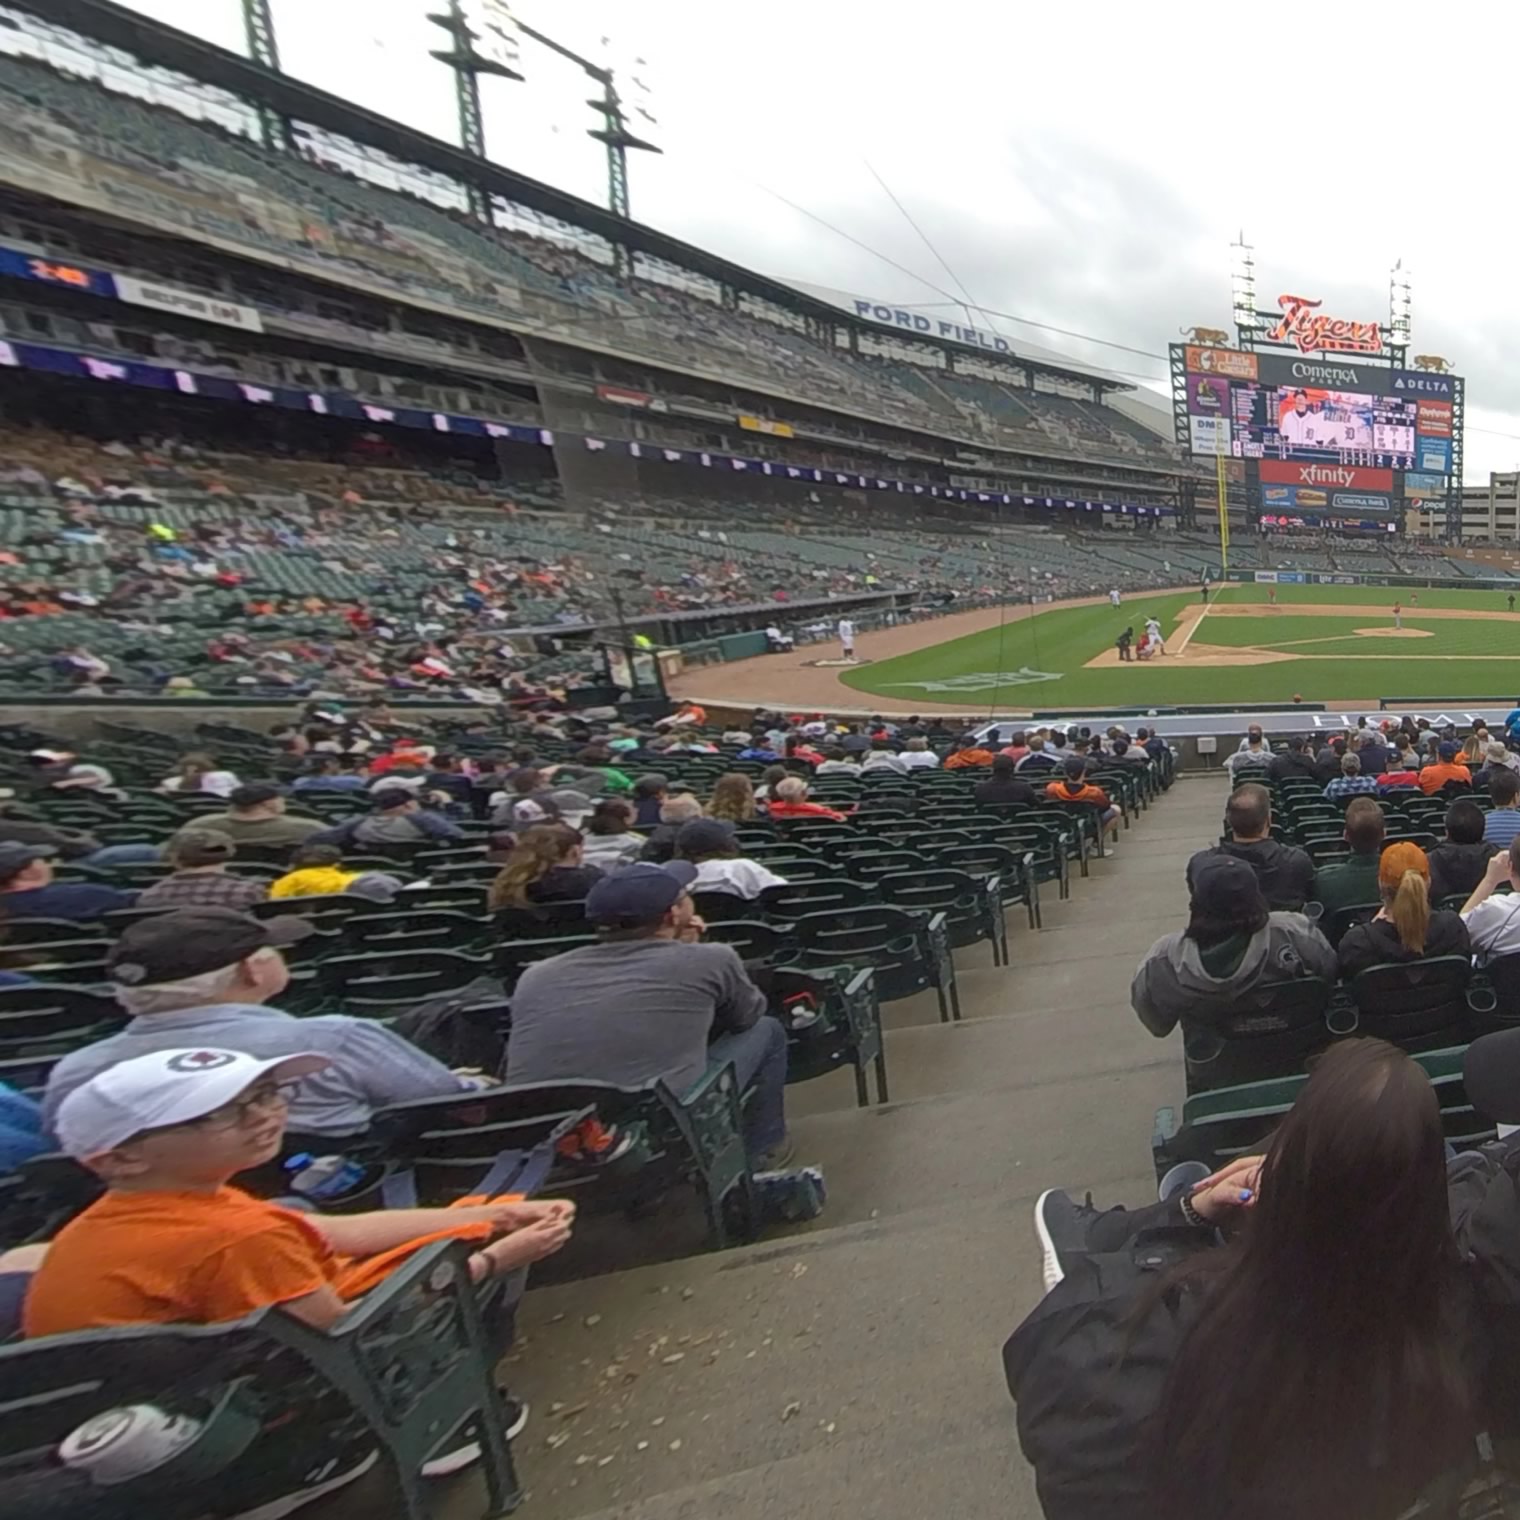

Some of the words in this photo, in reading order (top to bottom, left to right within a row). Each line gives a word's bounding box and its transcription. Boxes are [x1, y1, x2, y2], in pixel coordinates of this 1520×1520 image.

[854, 300, 931, 332] FORD
[937, 320, 1010, 352] FIELD
[1265, 293, 1382, 353] Tigers
[1407, 379, 1449, 392] DELTA
[1299, 464, 1355, 487] xfinity
[1423, 501, 1447, 510] pepsi
